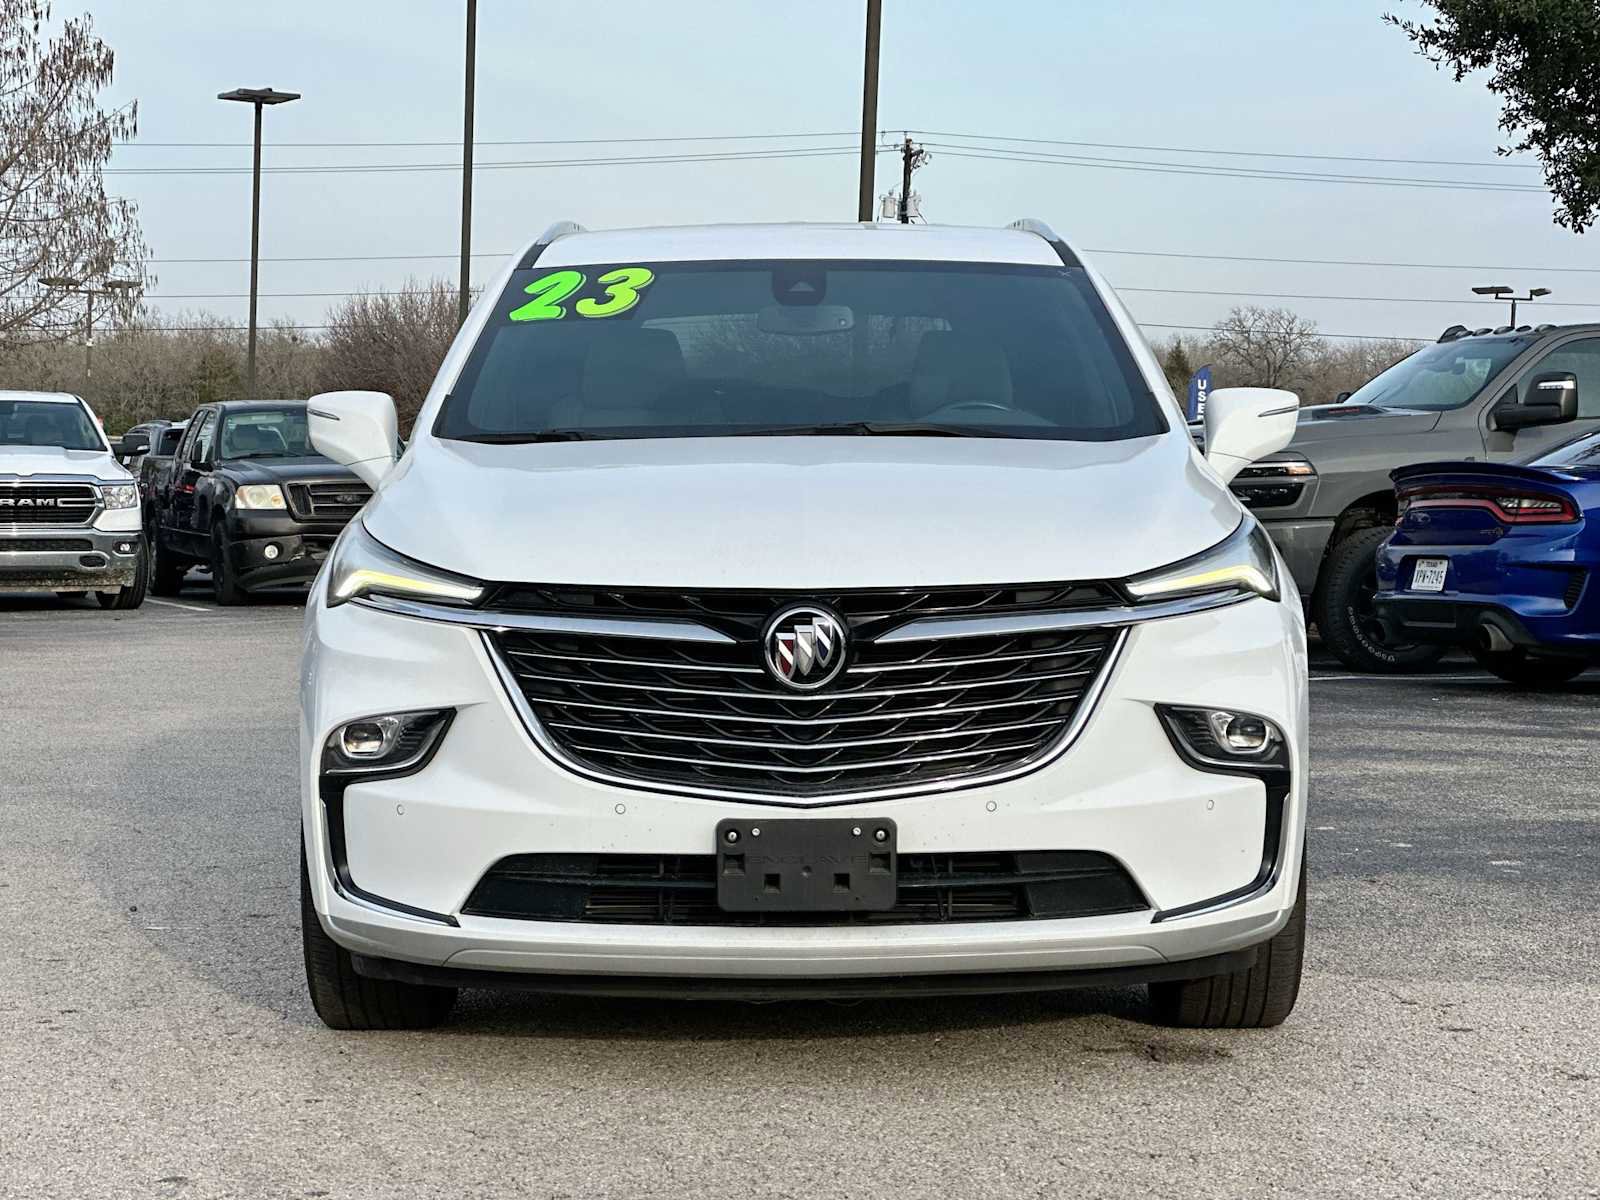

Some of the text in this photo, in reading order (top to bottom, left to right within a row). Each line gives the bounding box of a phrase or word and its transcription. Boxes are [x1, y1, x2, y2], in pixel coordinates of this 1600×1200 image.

[509, 267, 655, 321] 23
[0, 498, 55, 506] RAM
[747, 855, 869, 865] ENCLAVE
